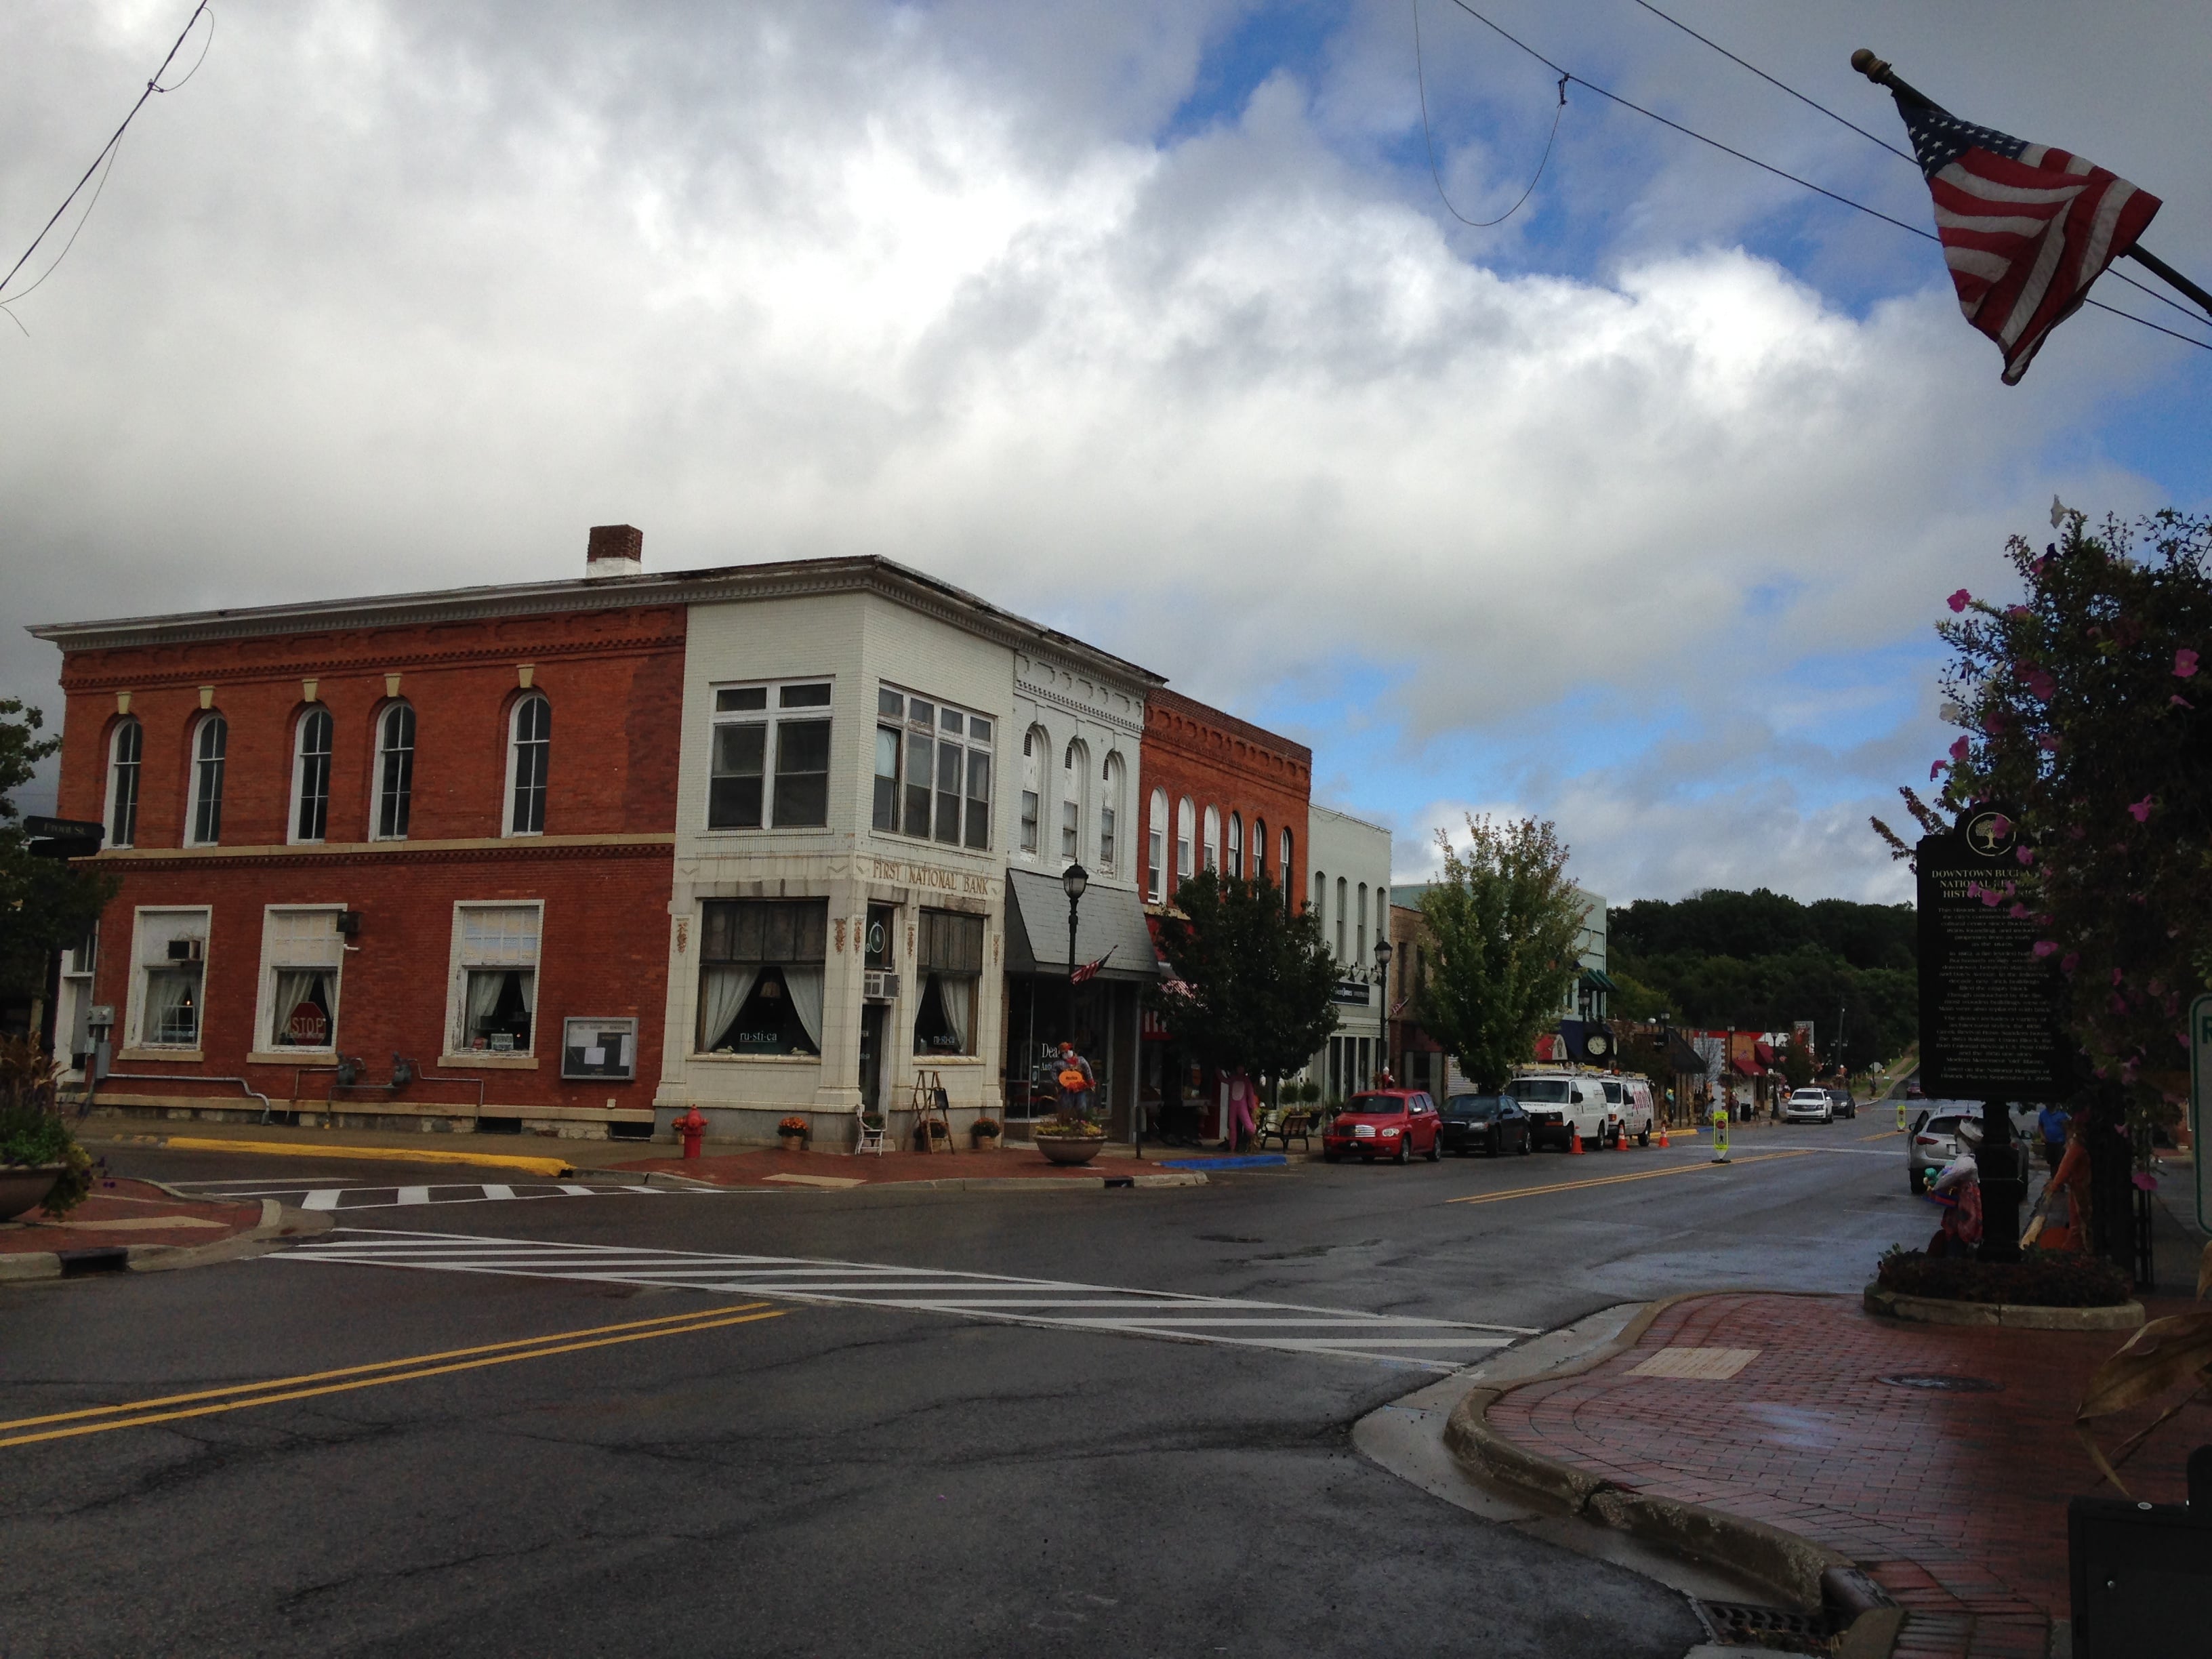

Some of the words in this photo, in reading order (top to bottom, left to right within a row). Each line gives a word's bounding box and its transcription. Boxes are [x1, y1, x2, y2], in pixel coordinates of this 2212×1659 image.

[874, 860, 901, 880] FIRST
[909, 865, 957, 891] NATIONAL
[962, 874, 989, 895] BANK
[1931, 869, 1992, 878] DOWNTOWN
[1940, 880, 1991, 888] NATIOAL
[292, 1017, 324, 1034] STOP
